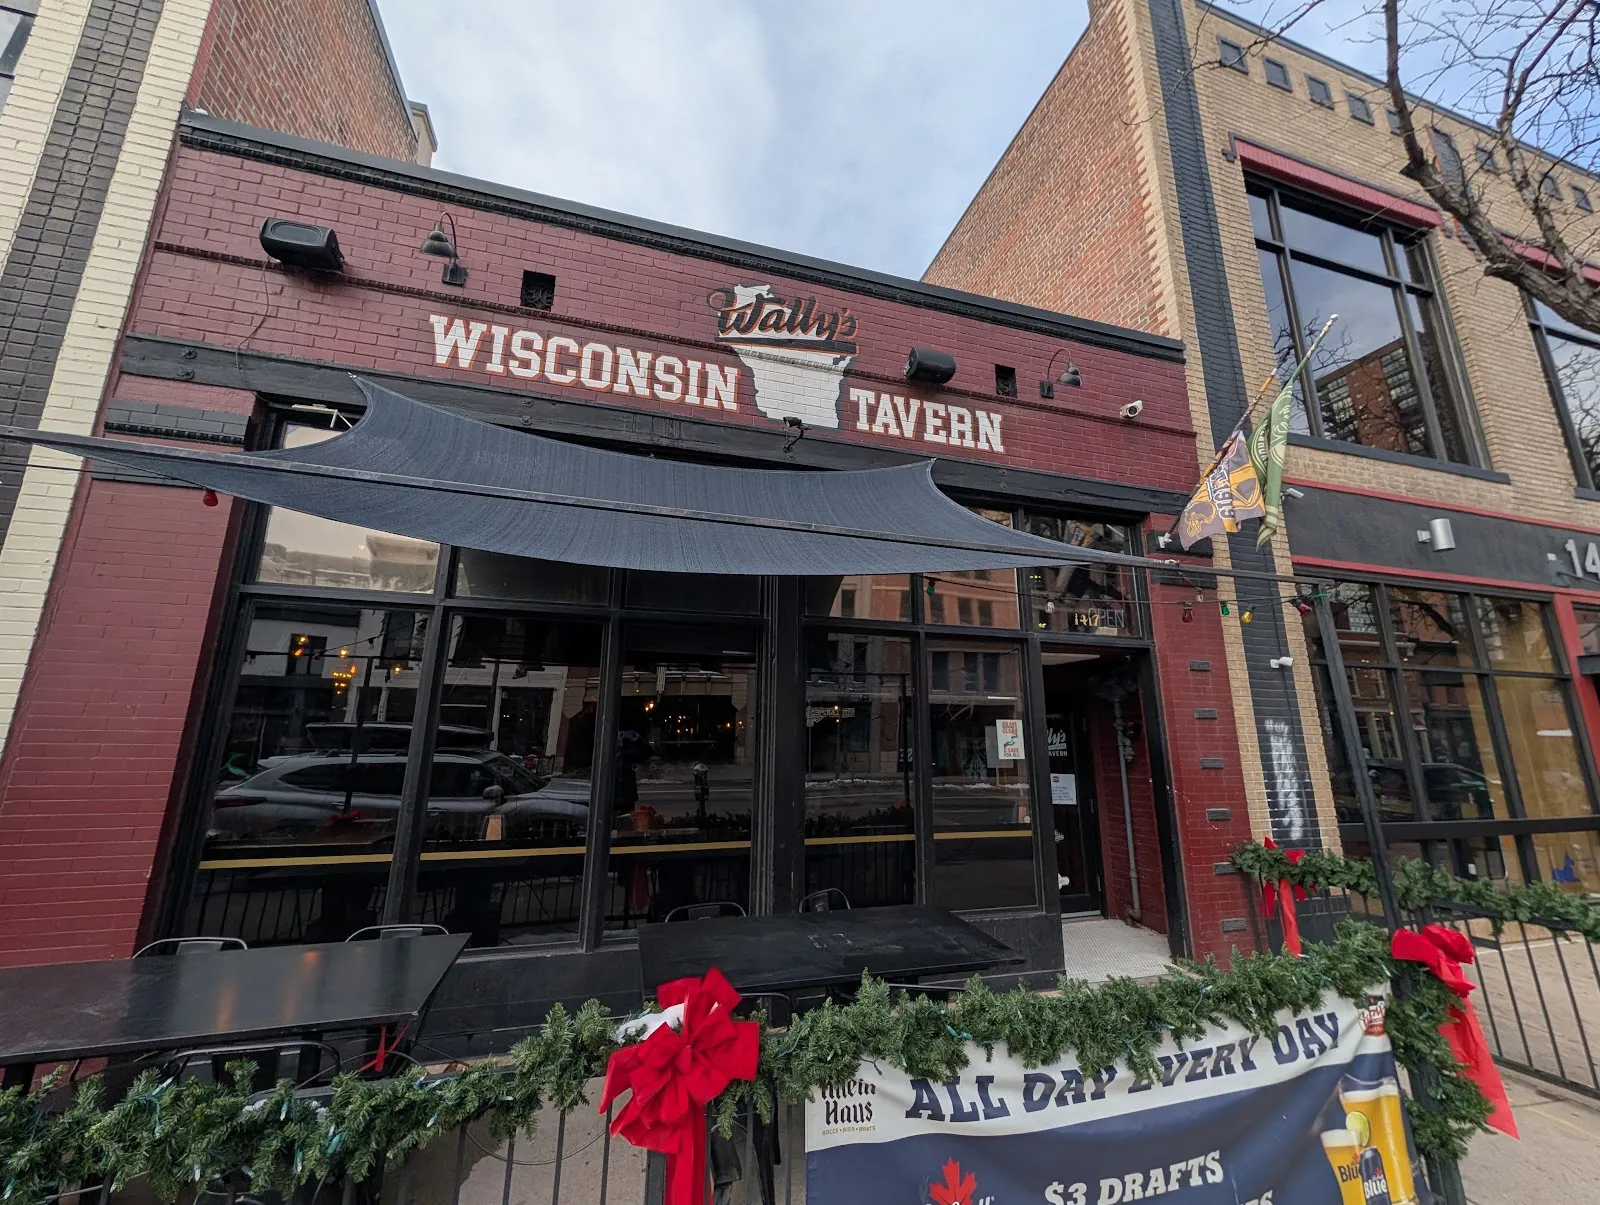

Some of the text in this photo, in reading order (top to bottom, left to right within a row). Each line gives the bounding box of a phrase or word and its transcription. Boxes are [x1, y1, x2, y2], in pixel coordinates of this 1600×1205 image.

[707, 288, 859, 341] Wally's
[429, 314, 741, 412] WISCONSIN
[849, 387, 1005, 454] TAVERN
[1088, 608, 1125, 628] OPEN
[905, 1075, 1011, 1122] ALL
[1022, 1065, 1118, 1113] DAY
[1271, 1012, 1340, 1065] DAY
[825, 1100, 873, 1126] Haus
[1097, 1150, 1223, 1205] DRAFTS
[1363, 1179, 1388, 1200] Blue
